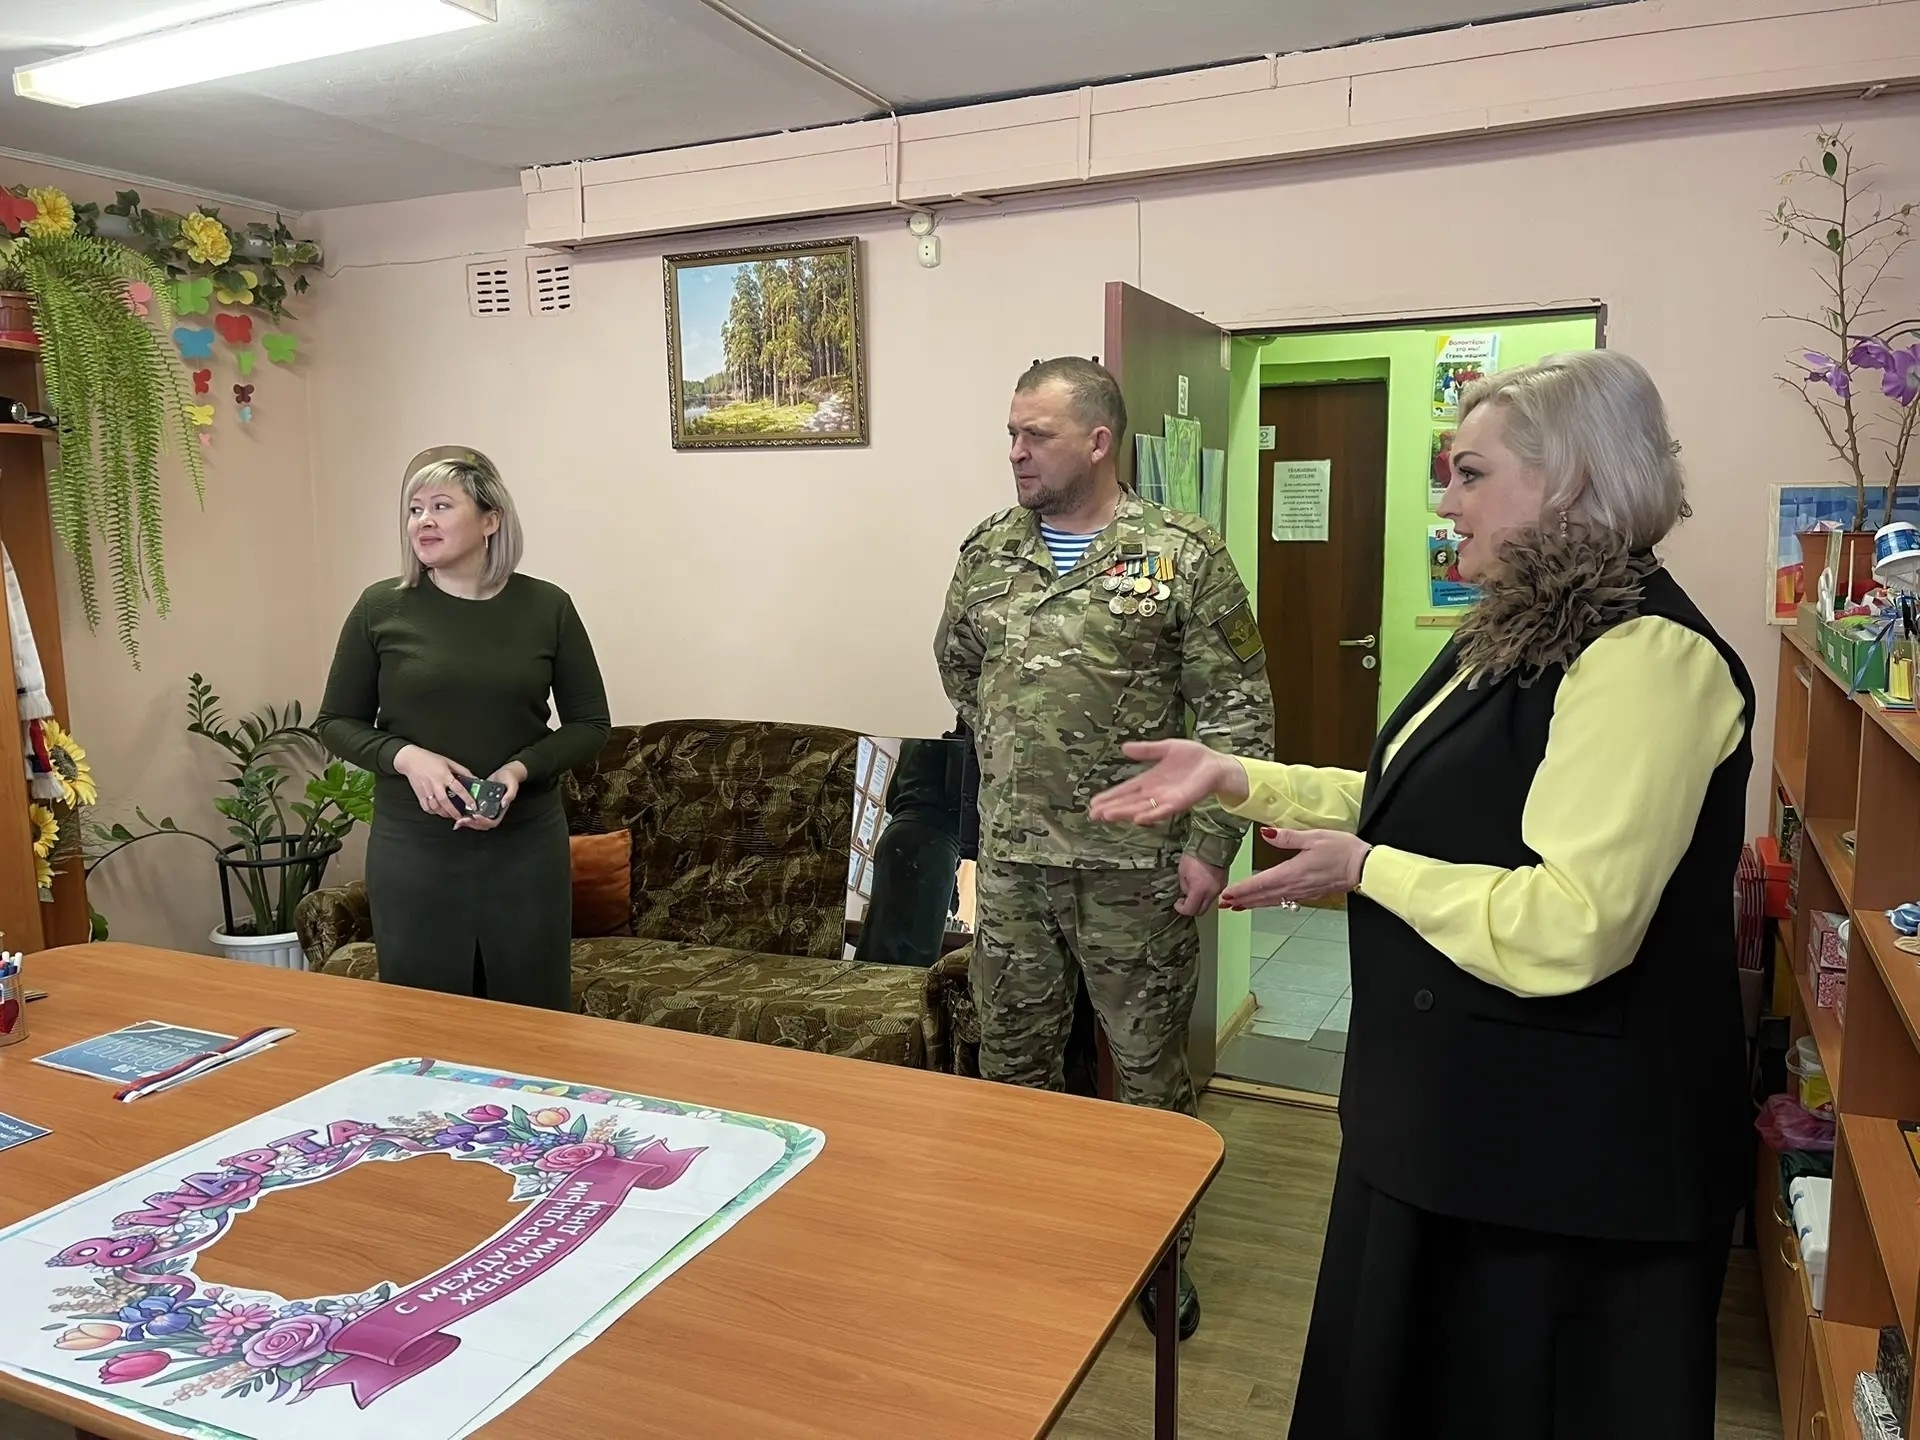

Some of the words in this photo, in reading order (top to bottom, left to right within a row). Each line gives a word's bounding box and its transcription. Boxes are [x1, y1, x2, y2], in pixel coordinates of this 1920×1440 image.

[47, 1237, 156, 1267] 8
[112, 1119, 387, 1229] МАРТА
[395, 1302, 419, 1315] С
[417, 1181, 594, 1302] МЕЖДУНАРОДНЫМ
[450, 1237, 566, 1306] ЖЕНСКИМ
[557, 1201, 607, 1236] ДНЕМ
